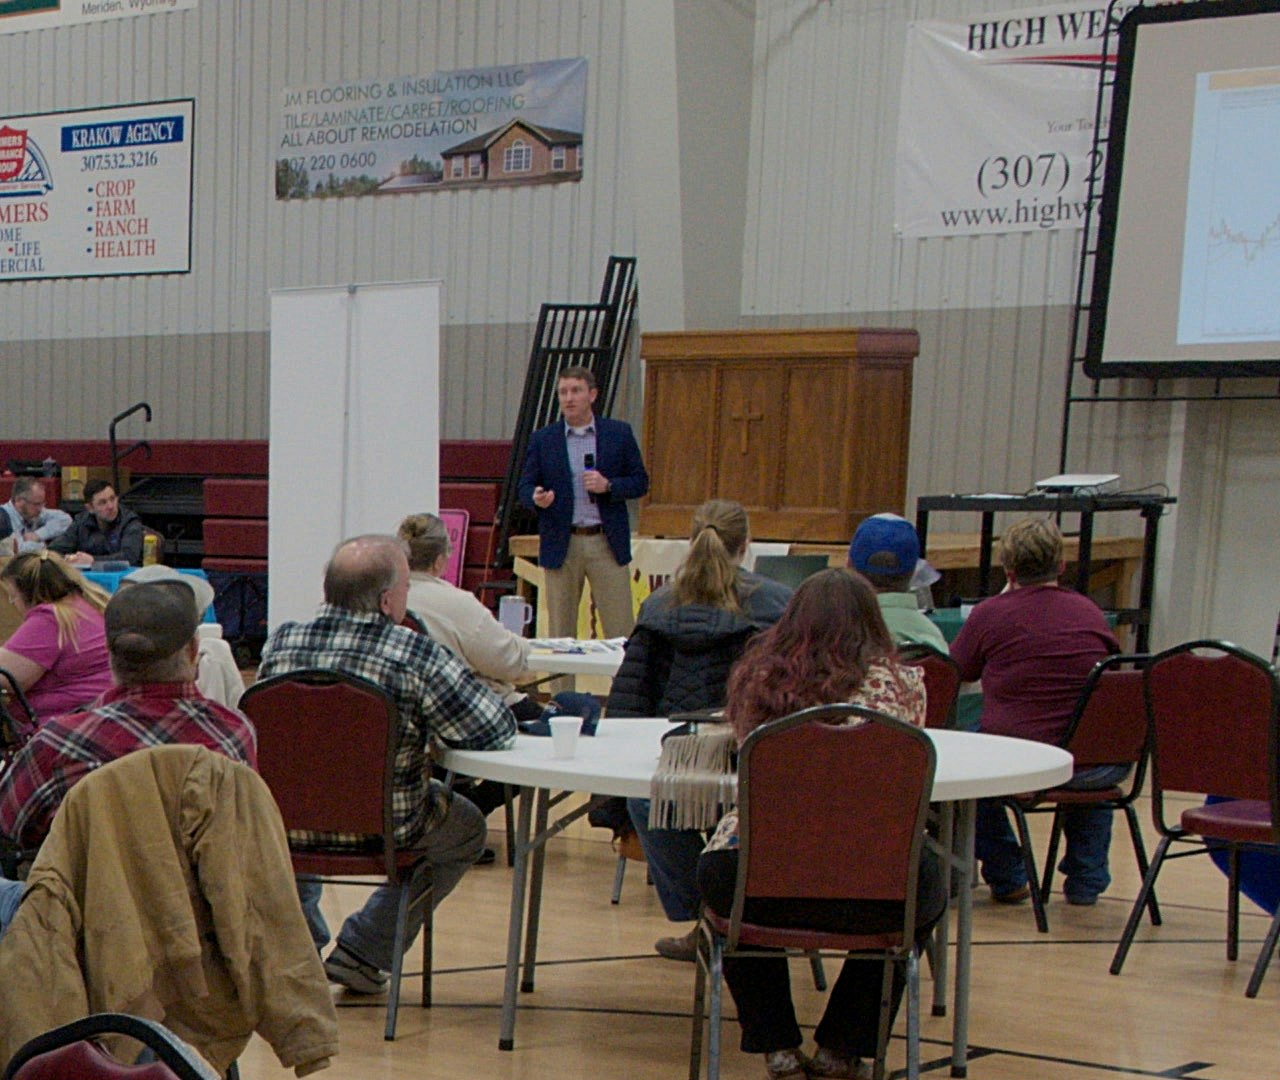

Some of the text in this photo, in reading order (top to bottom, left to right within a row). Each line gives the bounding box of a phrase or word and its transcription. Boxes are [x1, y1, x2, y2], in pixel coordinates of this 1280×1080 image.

[967, 3, 1137, 52] HIGH WES
[306, 83, 382, 106] FLOORING
[385, 81, 397, 97] &
[401, 73, 494, 96] INSULATION
[497, 70, 527, 88] LLC
[71, 120, 176, 150] KRAKOW AGENCY
[280, 117, 479, 149] ALL ABOUT REMODELATION
[309, 154, 337, 171] 220
[339, 152, 377, 170] 0600
[976, 150, 1071, 198] (307)
[94, 178, 136, 198] CROP
[95, 199, 137, 218] FARM
[94, 218, 149, 238] RANCH
[14, 241, 41, 257] LIFE
[94, 239, 156, 259] HEALTH
